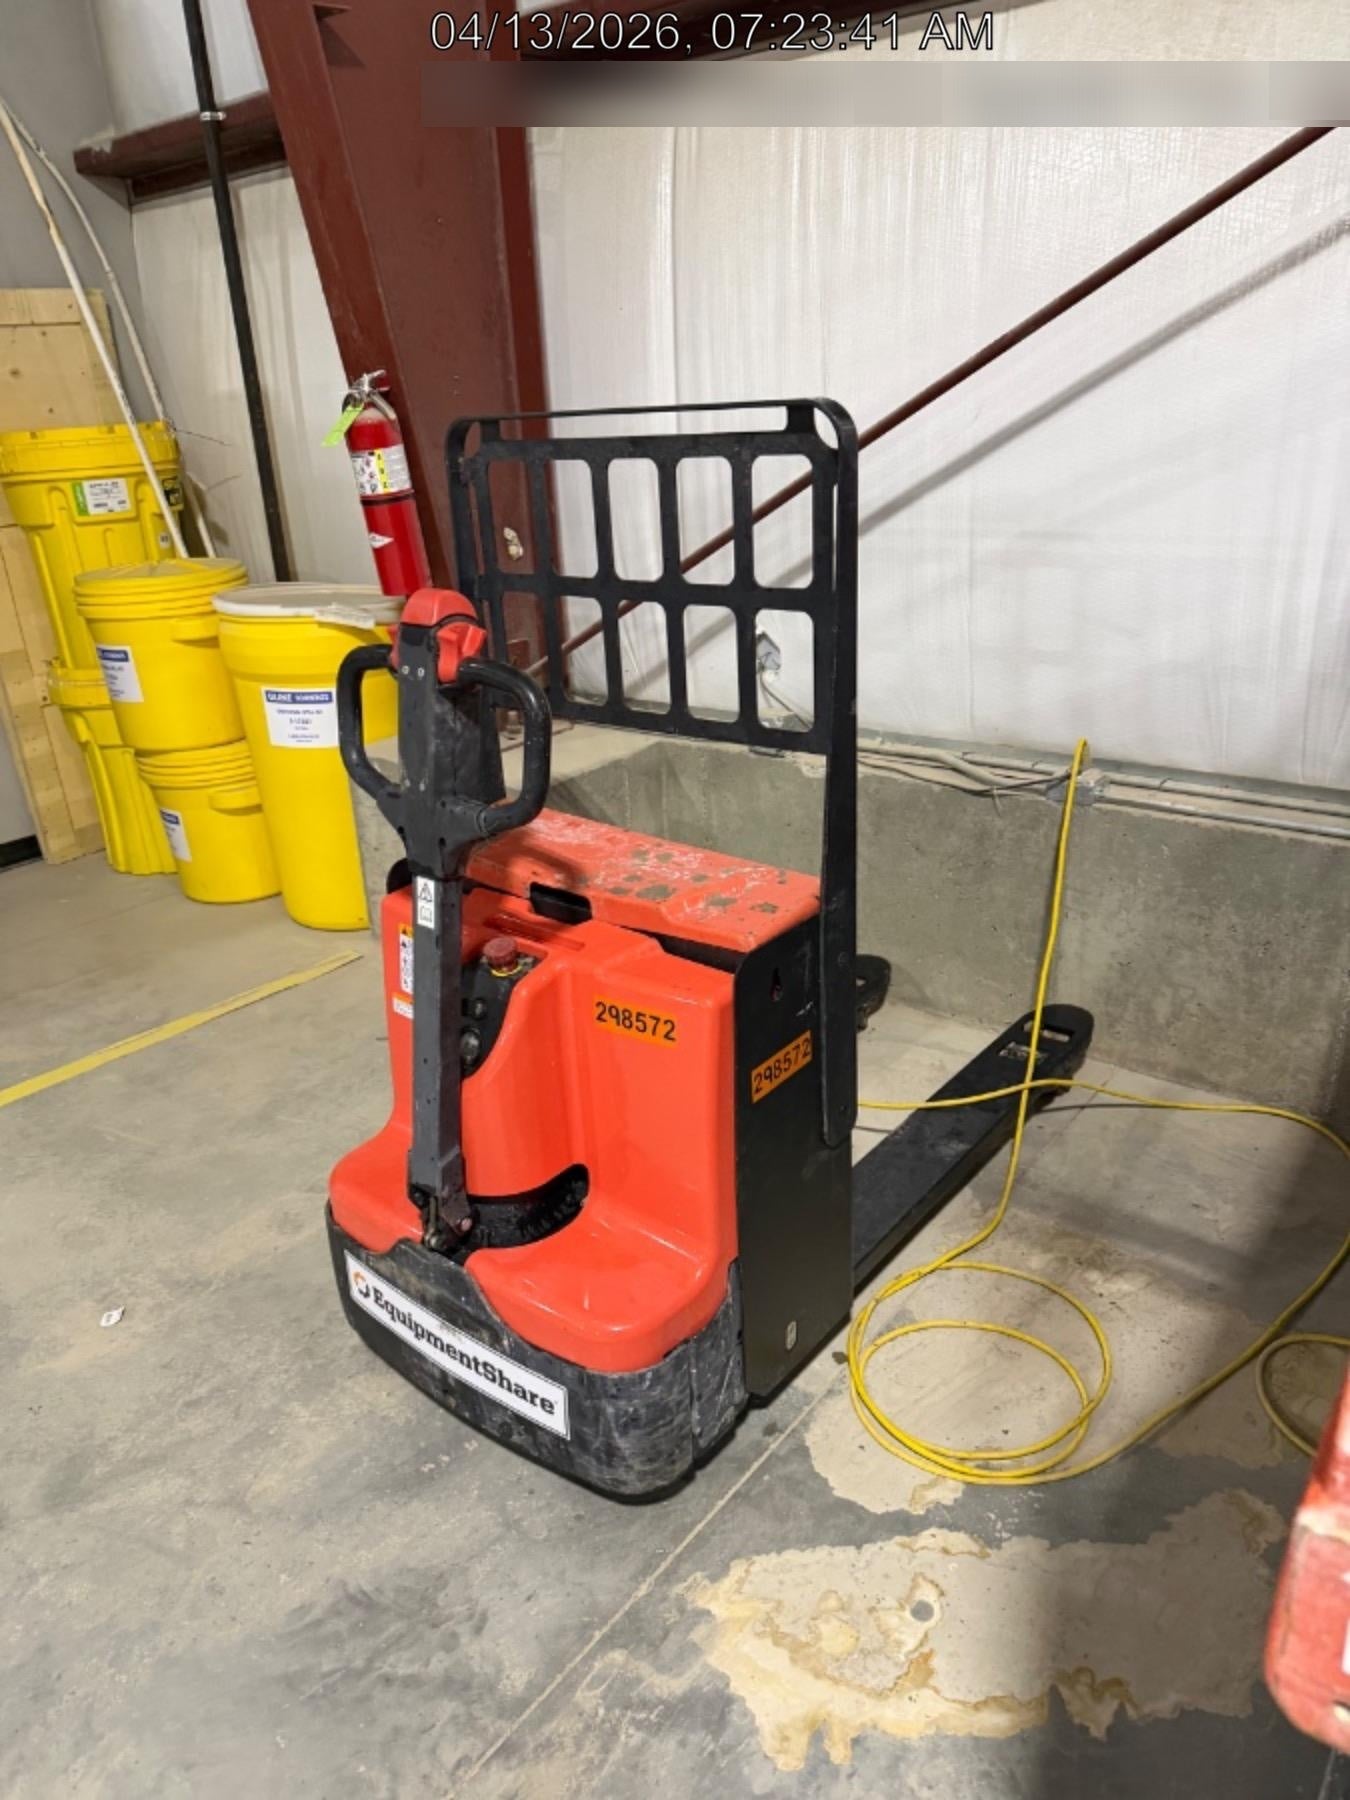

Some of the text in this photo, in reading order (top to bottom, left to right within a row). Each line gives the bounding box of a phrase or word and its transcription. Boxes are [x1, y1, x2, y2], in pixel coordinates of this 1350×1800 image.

[596, 1002, 676, 1041] 298572
[754, 1038, 811, 1094] 298572
[373, 1286, 555, 1415] EquipmentShare
